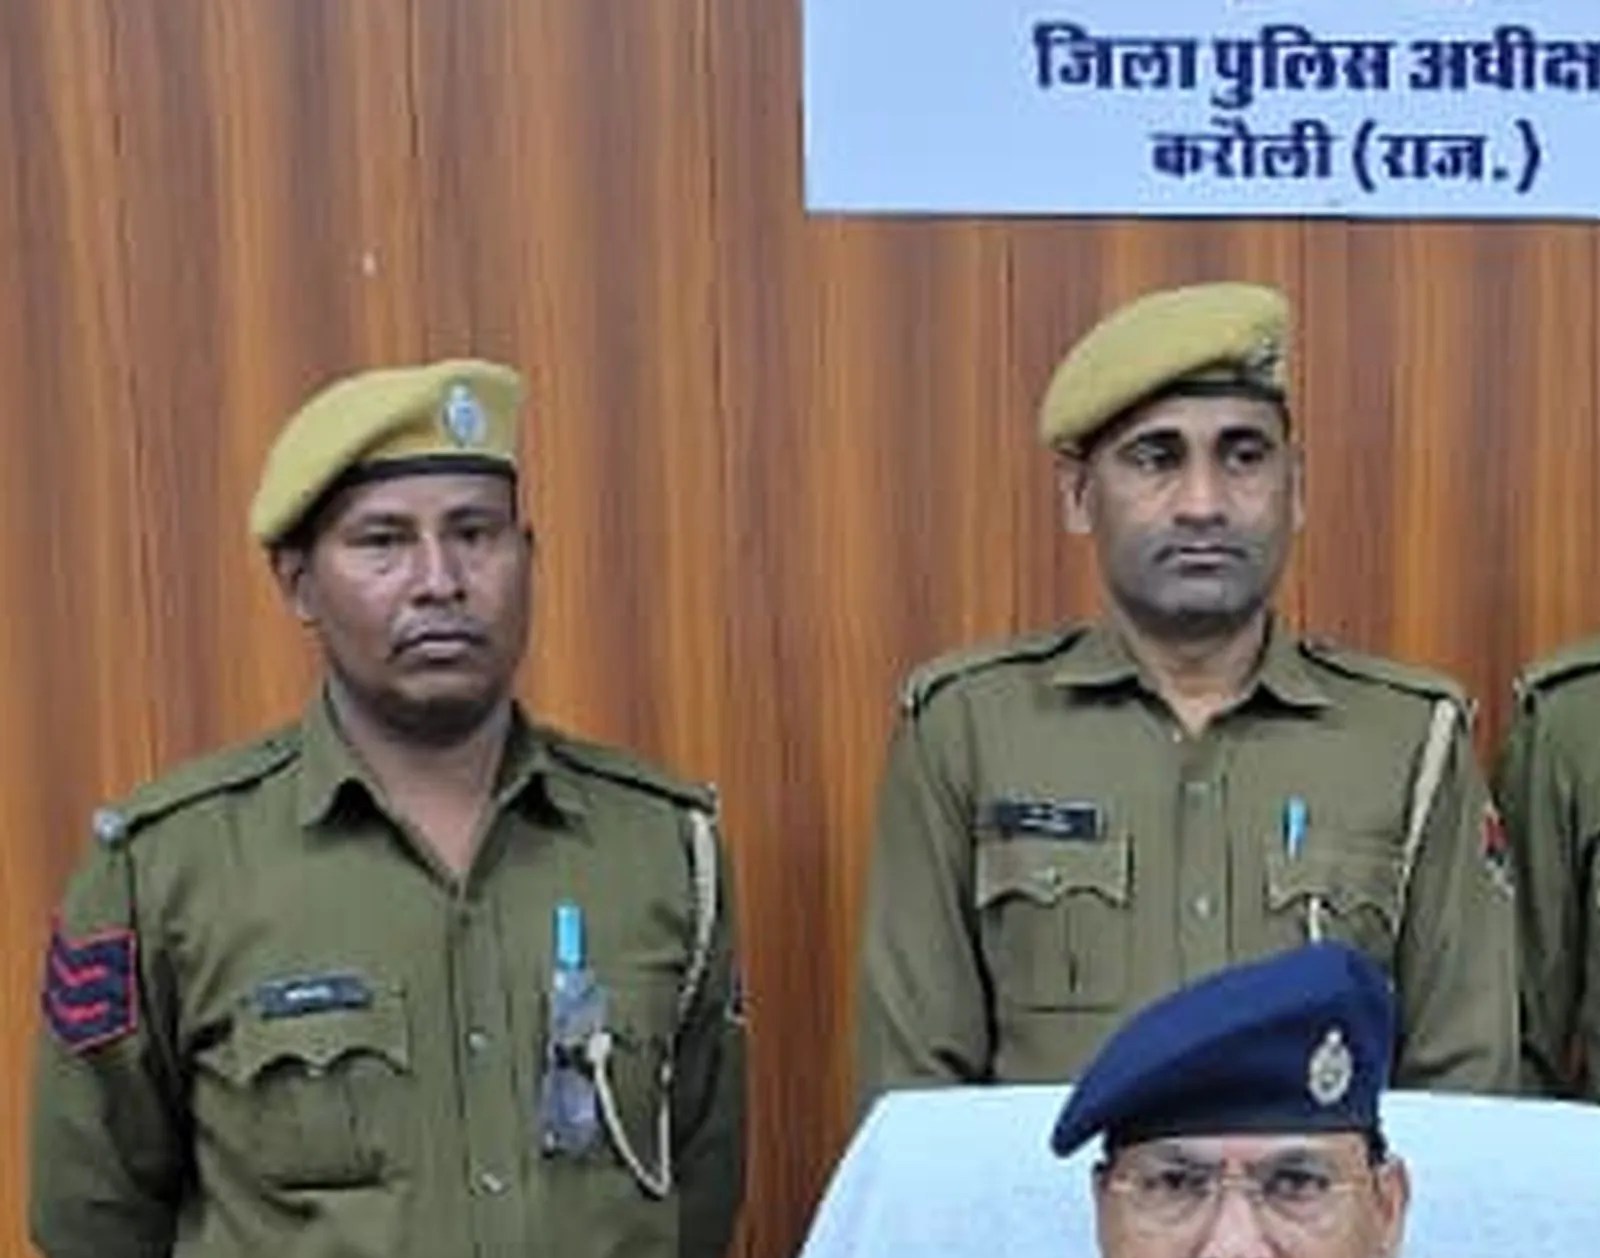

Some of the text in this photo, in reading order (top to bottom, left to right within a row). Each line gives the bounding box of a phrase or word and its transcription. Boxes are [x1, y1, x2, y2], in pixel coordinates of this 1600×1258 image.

[1033, 22, 1200, 90] जिला
[1210, 23, 1398, 111] पुलिस
[1151, 115, 1542, 194] करौली (राज.)
